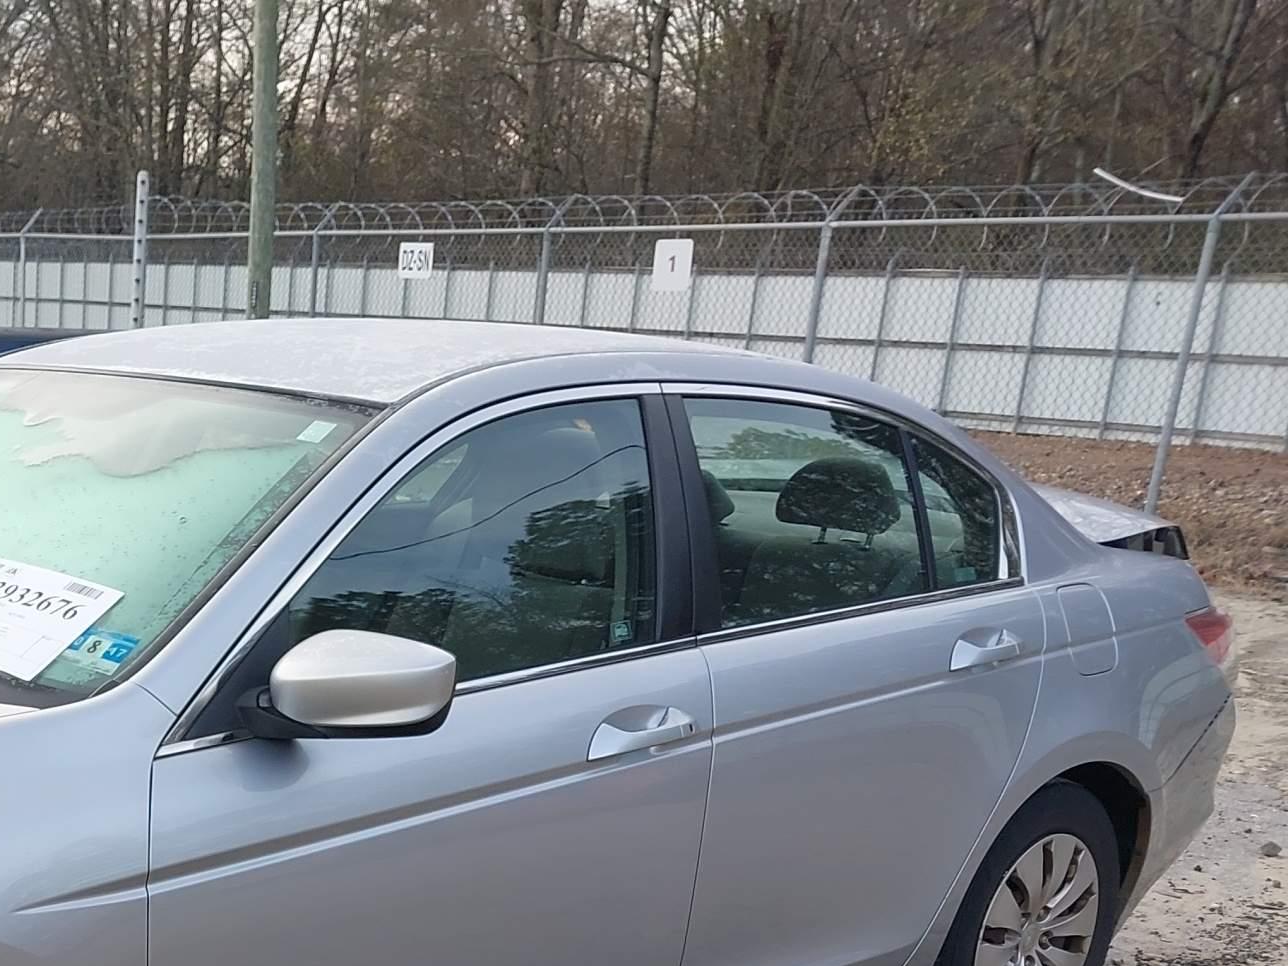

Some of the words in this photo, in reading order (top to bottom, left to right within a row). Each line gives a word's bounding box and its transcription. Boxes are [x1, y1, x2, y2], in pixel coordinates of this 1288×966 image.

[401, 250, 431, 272] DZ-SN
[668, 255, 678, 273] 1
[87, 640, 103, 654] 8
